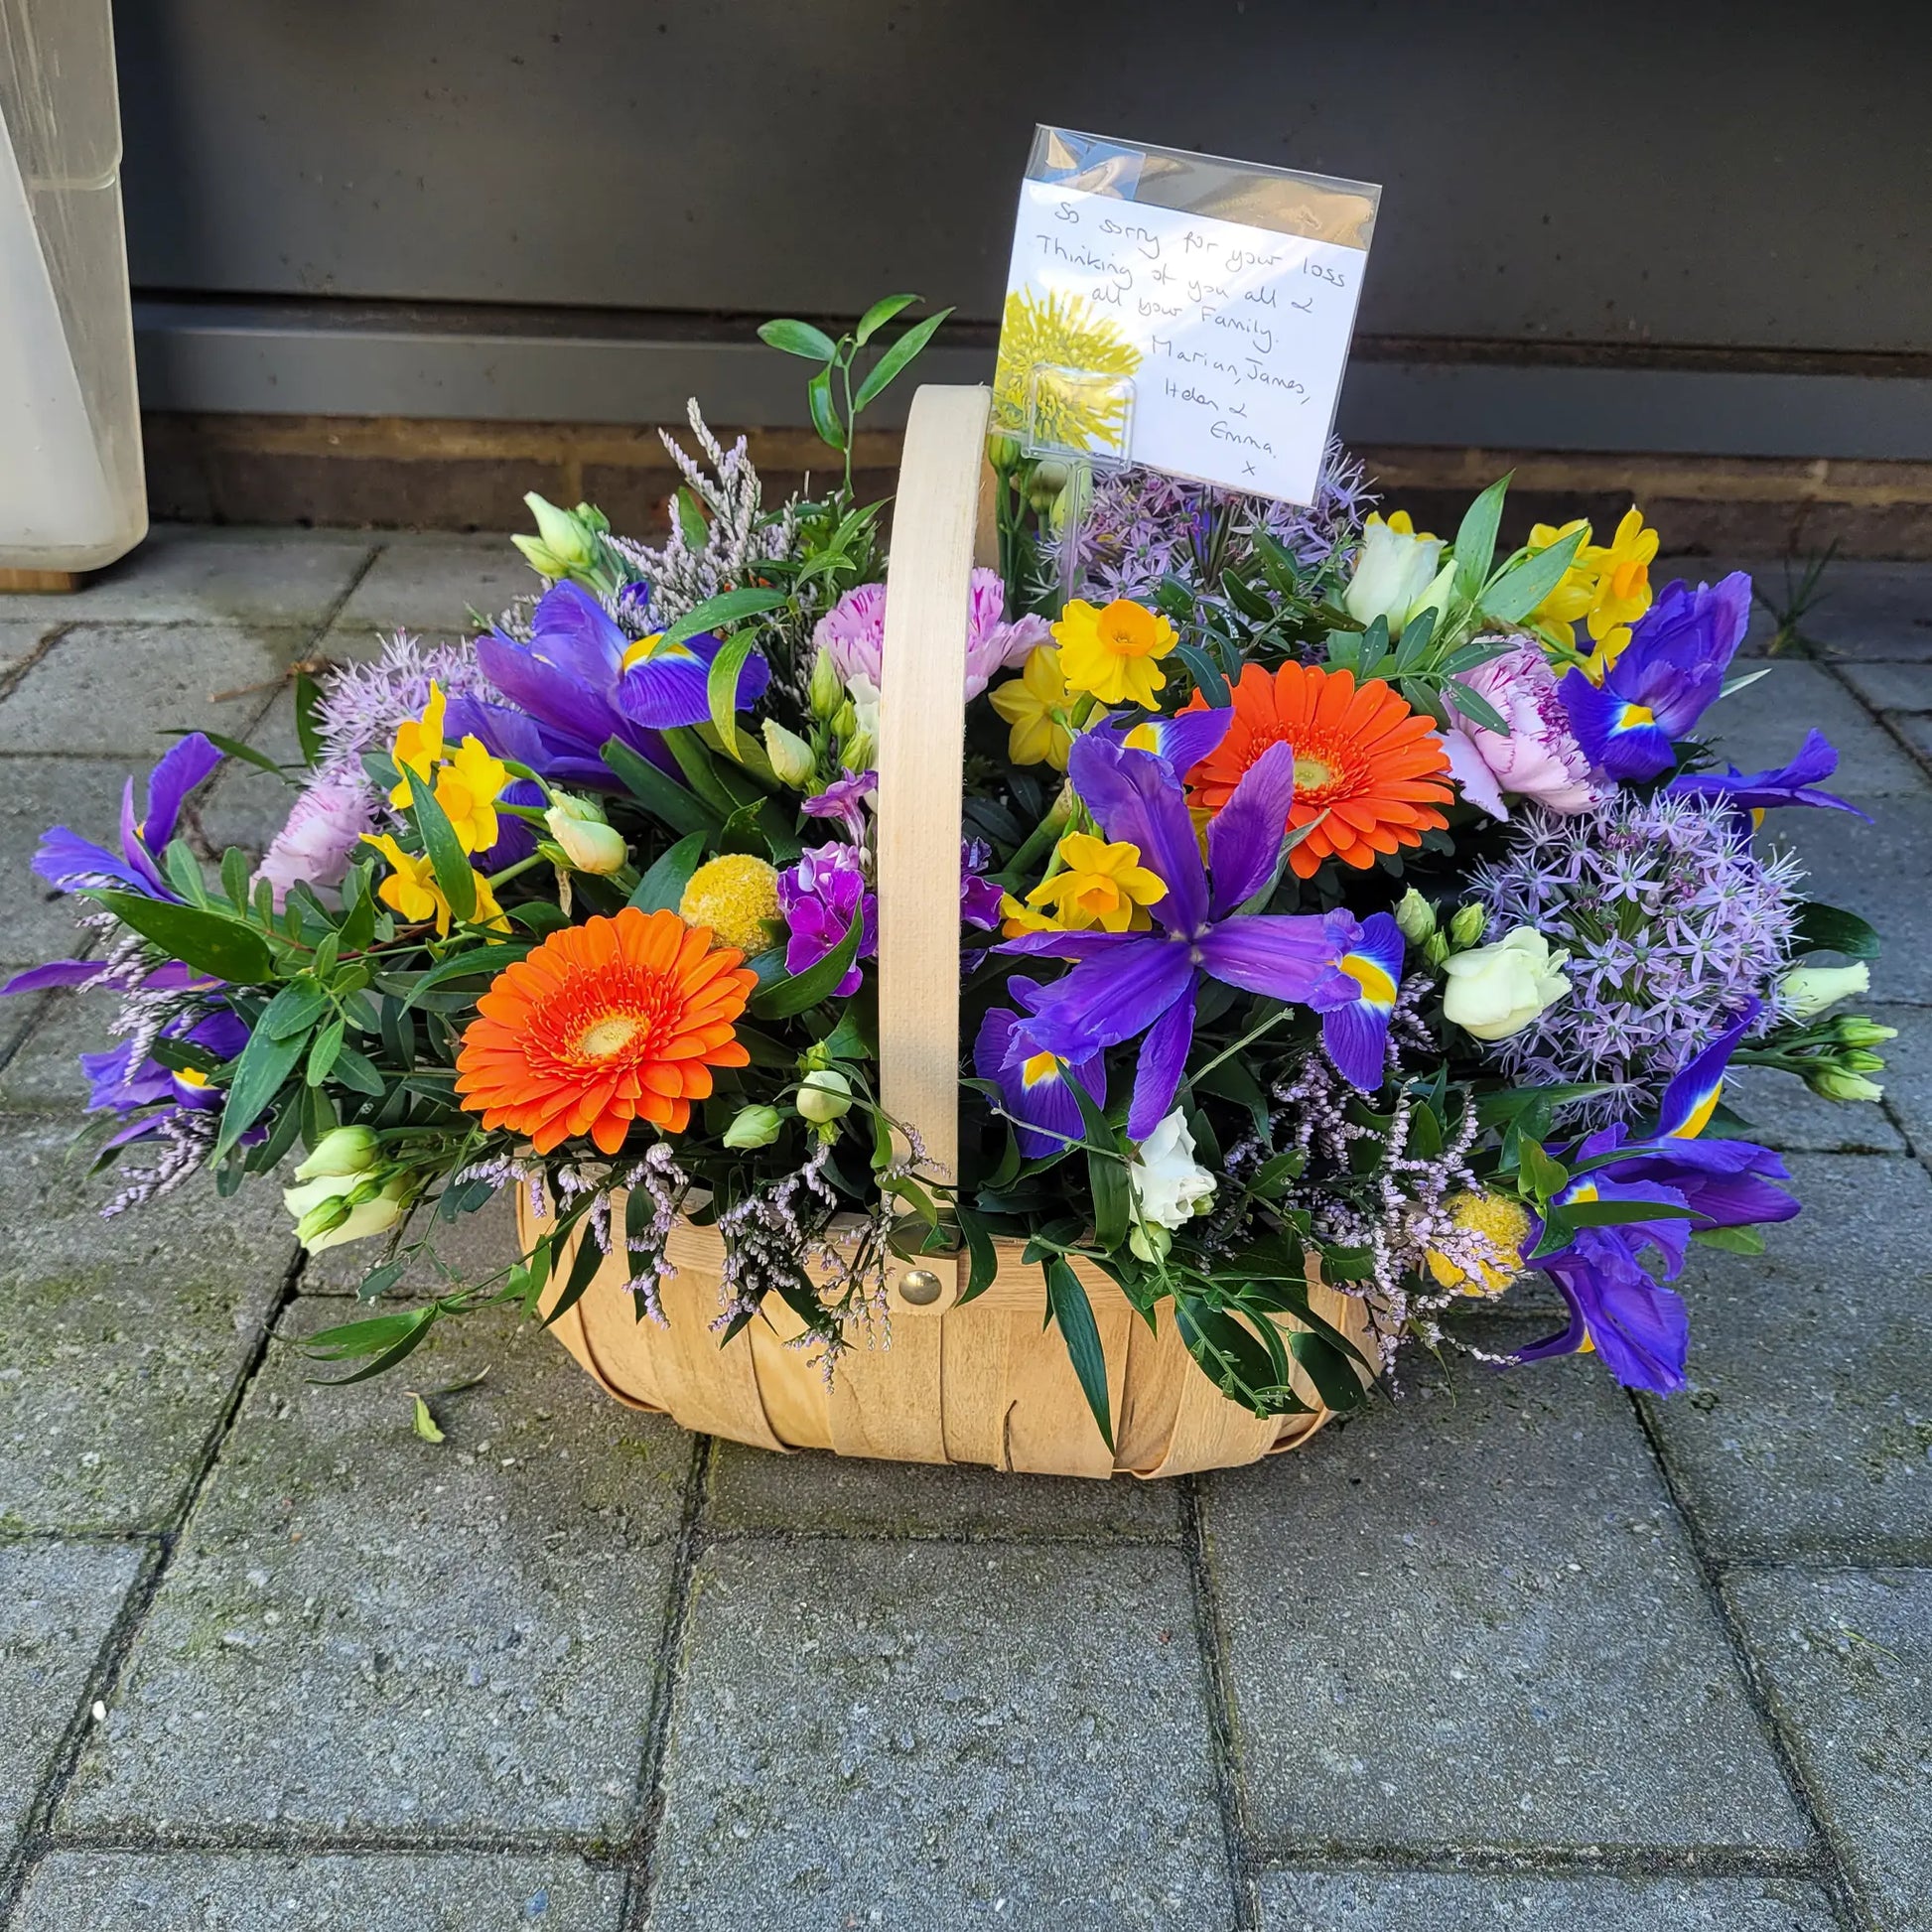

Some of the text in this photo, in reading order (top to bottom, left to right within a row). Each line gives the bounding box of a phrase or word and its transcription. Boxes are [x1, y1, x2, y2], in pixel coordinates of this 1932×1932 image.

[1036, 234, 1133, 290] Thinking
[1152, 263, 1176, 285] of
[1188, 280, 1228, 302] you
[1245, 287, 1276, 308] all
[1054, 202, 1345, 287] So sorry for your loss
[1092, 285, 1122, 306] all
[1138, 297, 1182, 317] your
[1165, 378, 1219, 411] Helen
